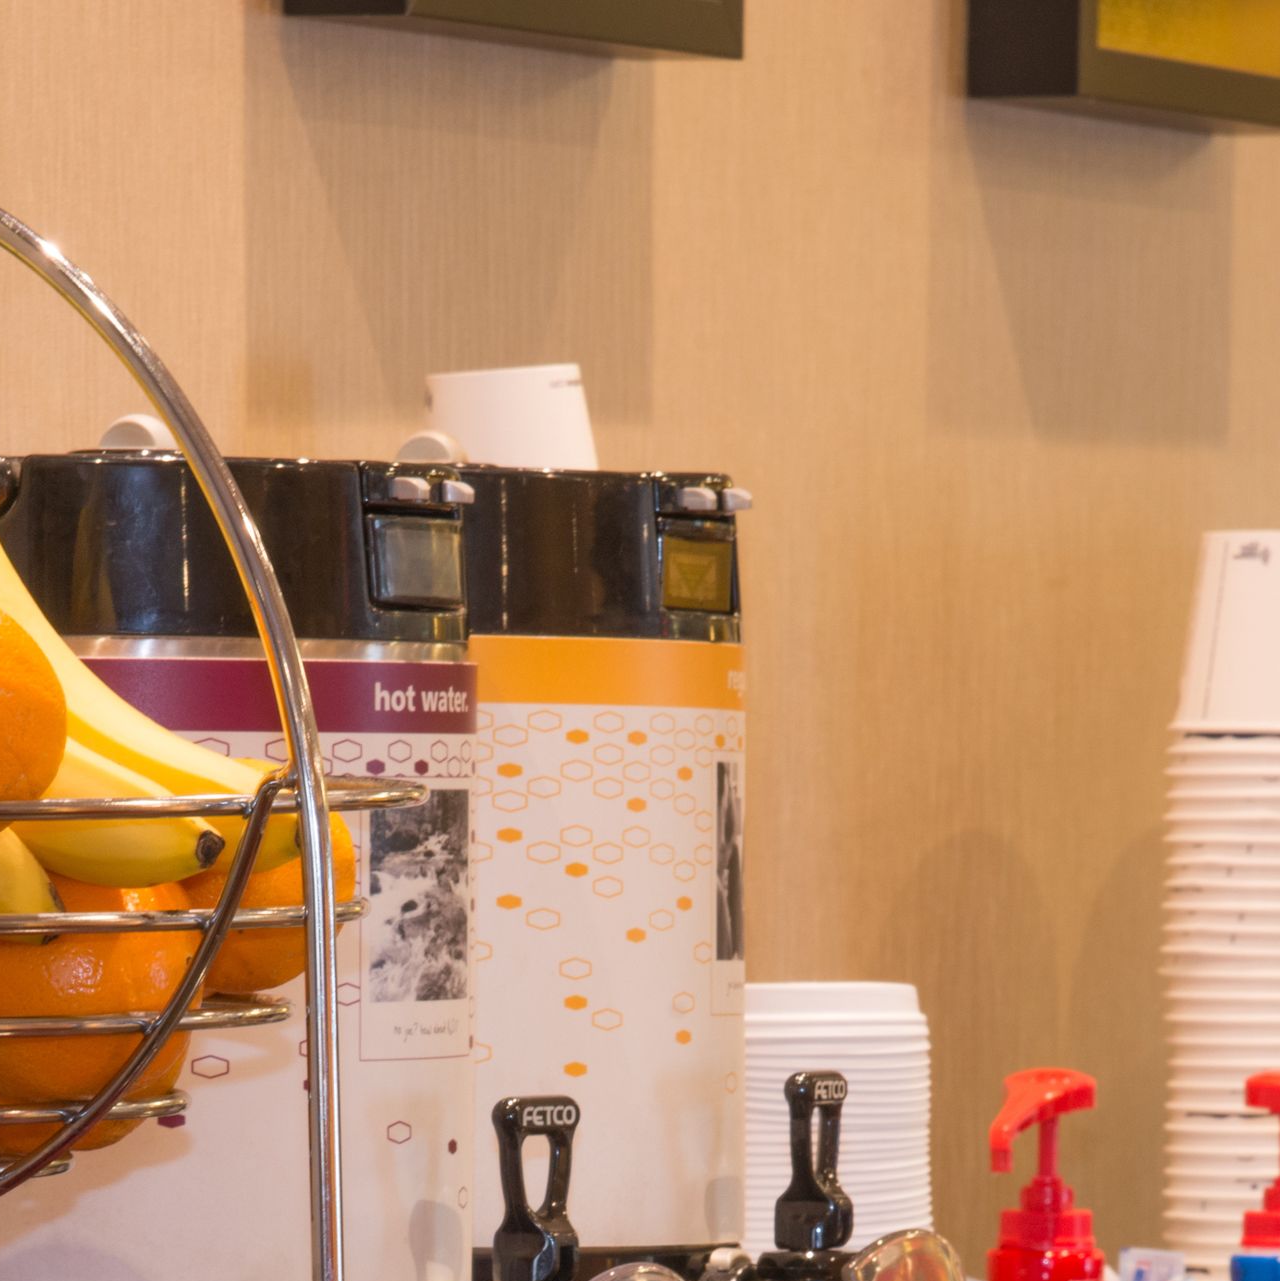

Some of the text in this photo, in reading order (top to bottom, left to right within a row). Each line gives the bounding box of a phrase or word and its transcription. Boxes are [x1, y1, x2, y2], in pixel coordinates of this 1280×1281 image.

[374, 681, 469, 713] hot water.
[814, 1080, 846, 1099] FETCO
[522, 1105, 576, 1126] FETCO
